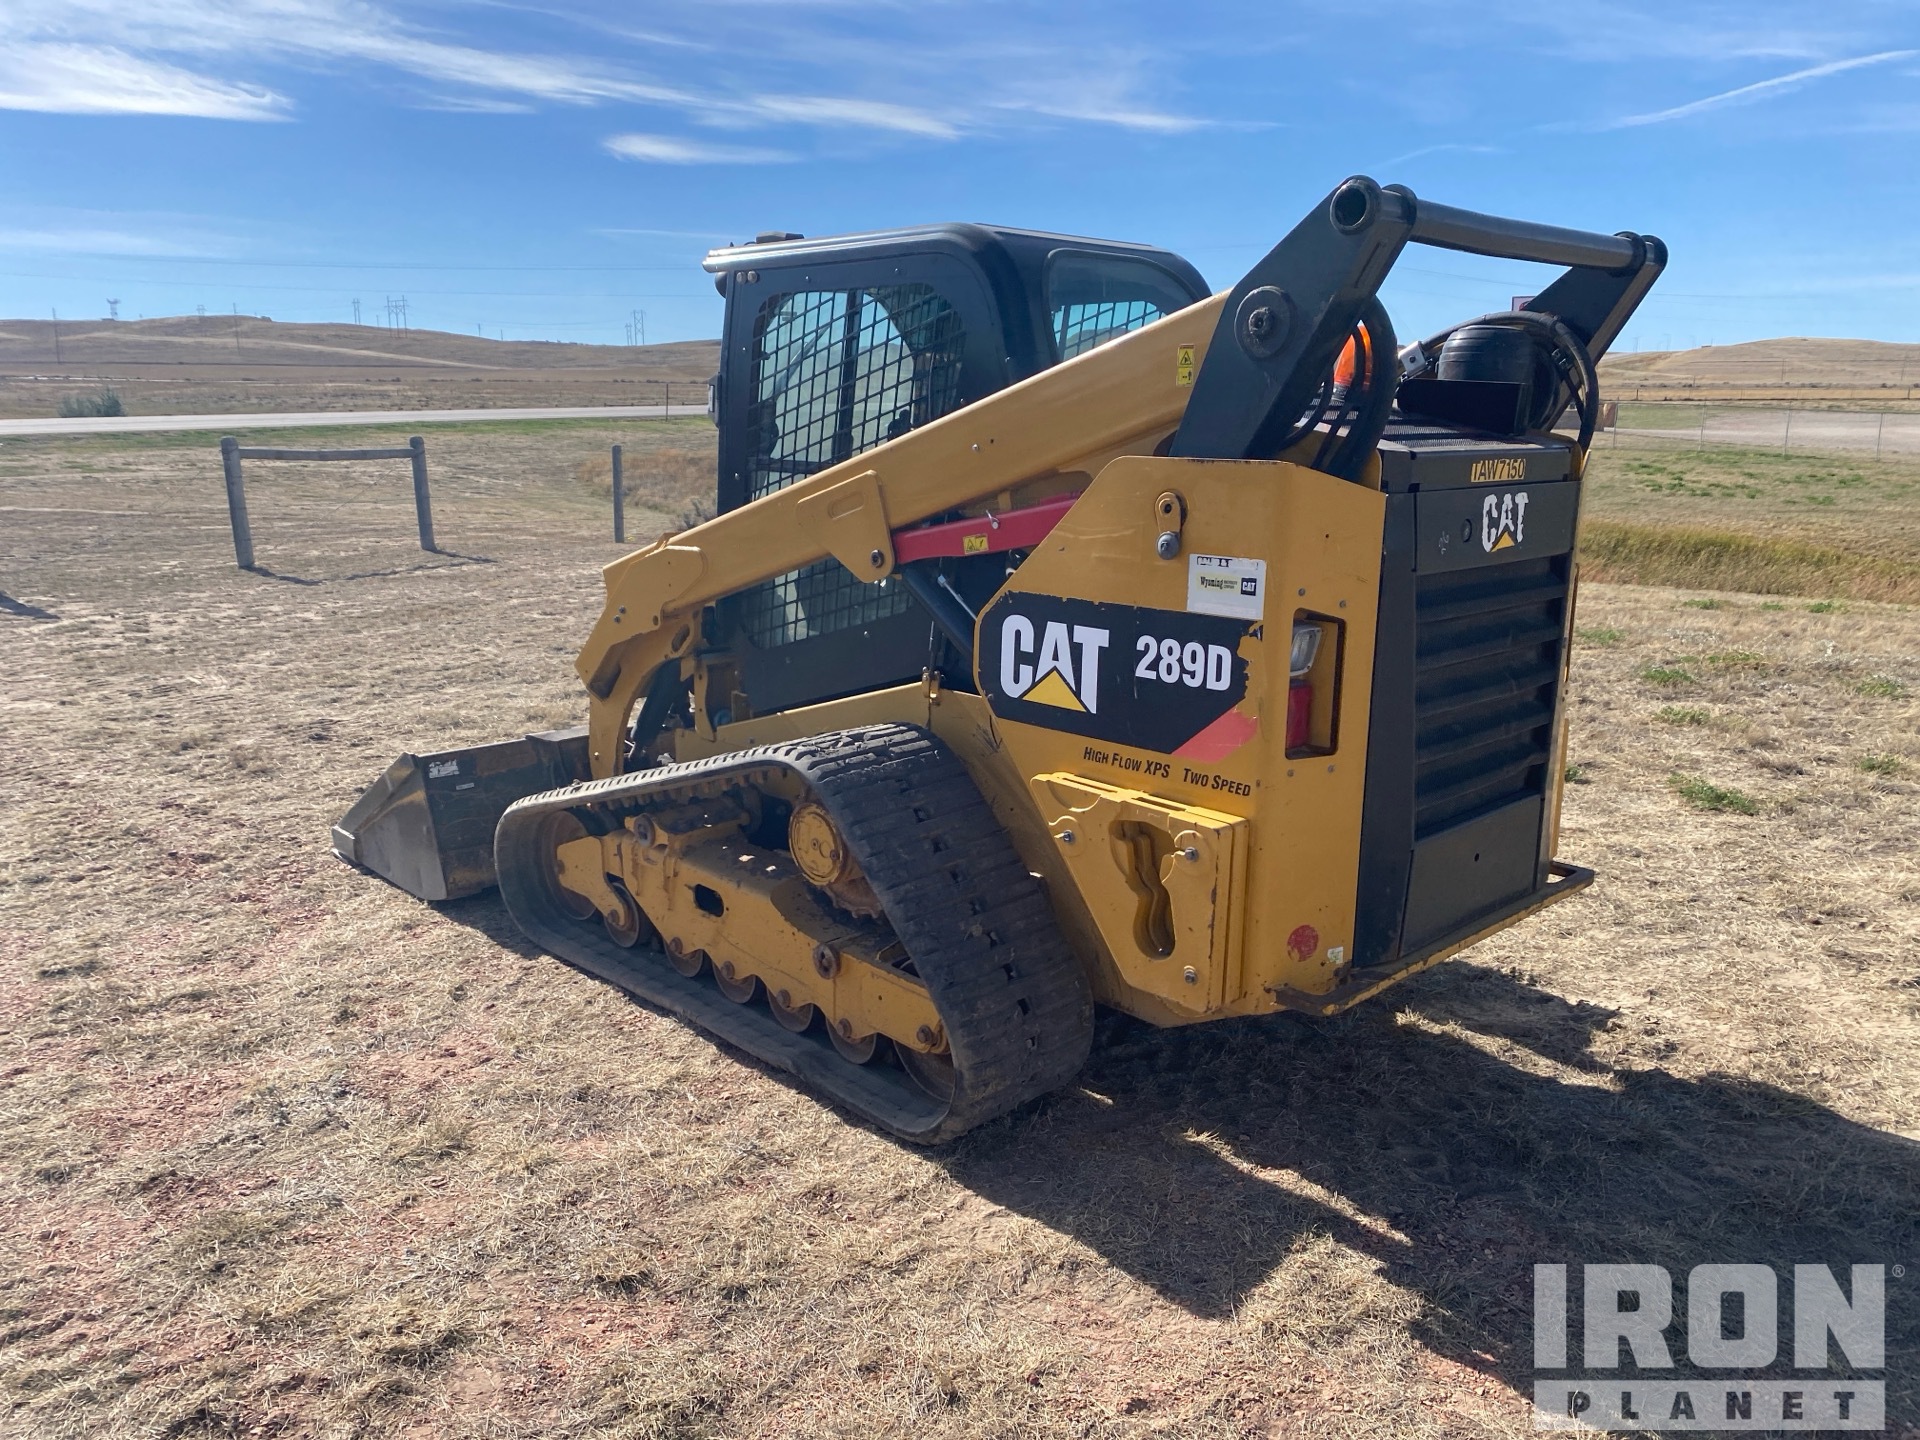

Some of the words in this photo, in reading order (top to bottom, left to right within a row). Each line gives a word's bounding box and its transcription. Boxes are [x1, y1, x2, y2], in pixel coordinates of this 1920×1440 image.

[1472, 458, 1525, 481] TAW7150
[1482, 492, 1529, 552] CAT
[1200, 576, 1223, 589] Wyoming
[1242, 581, 1256, 592] CAT
[1000, 614, 1110, 714] CAT
[1135, 634, 1232, 691] 289D
[1144, 759, 1171, 779] XPS
